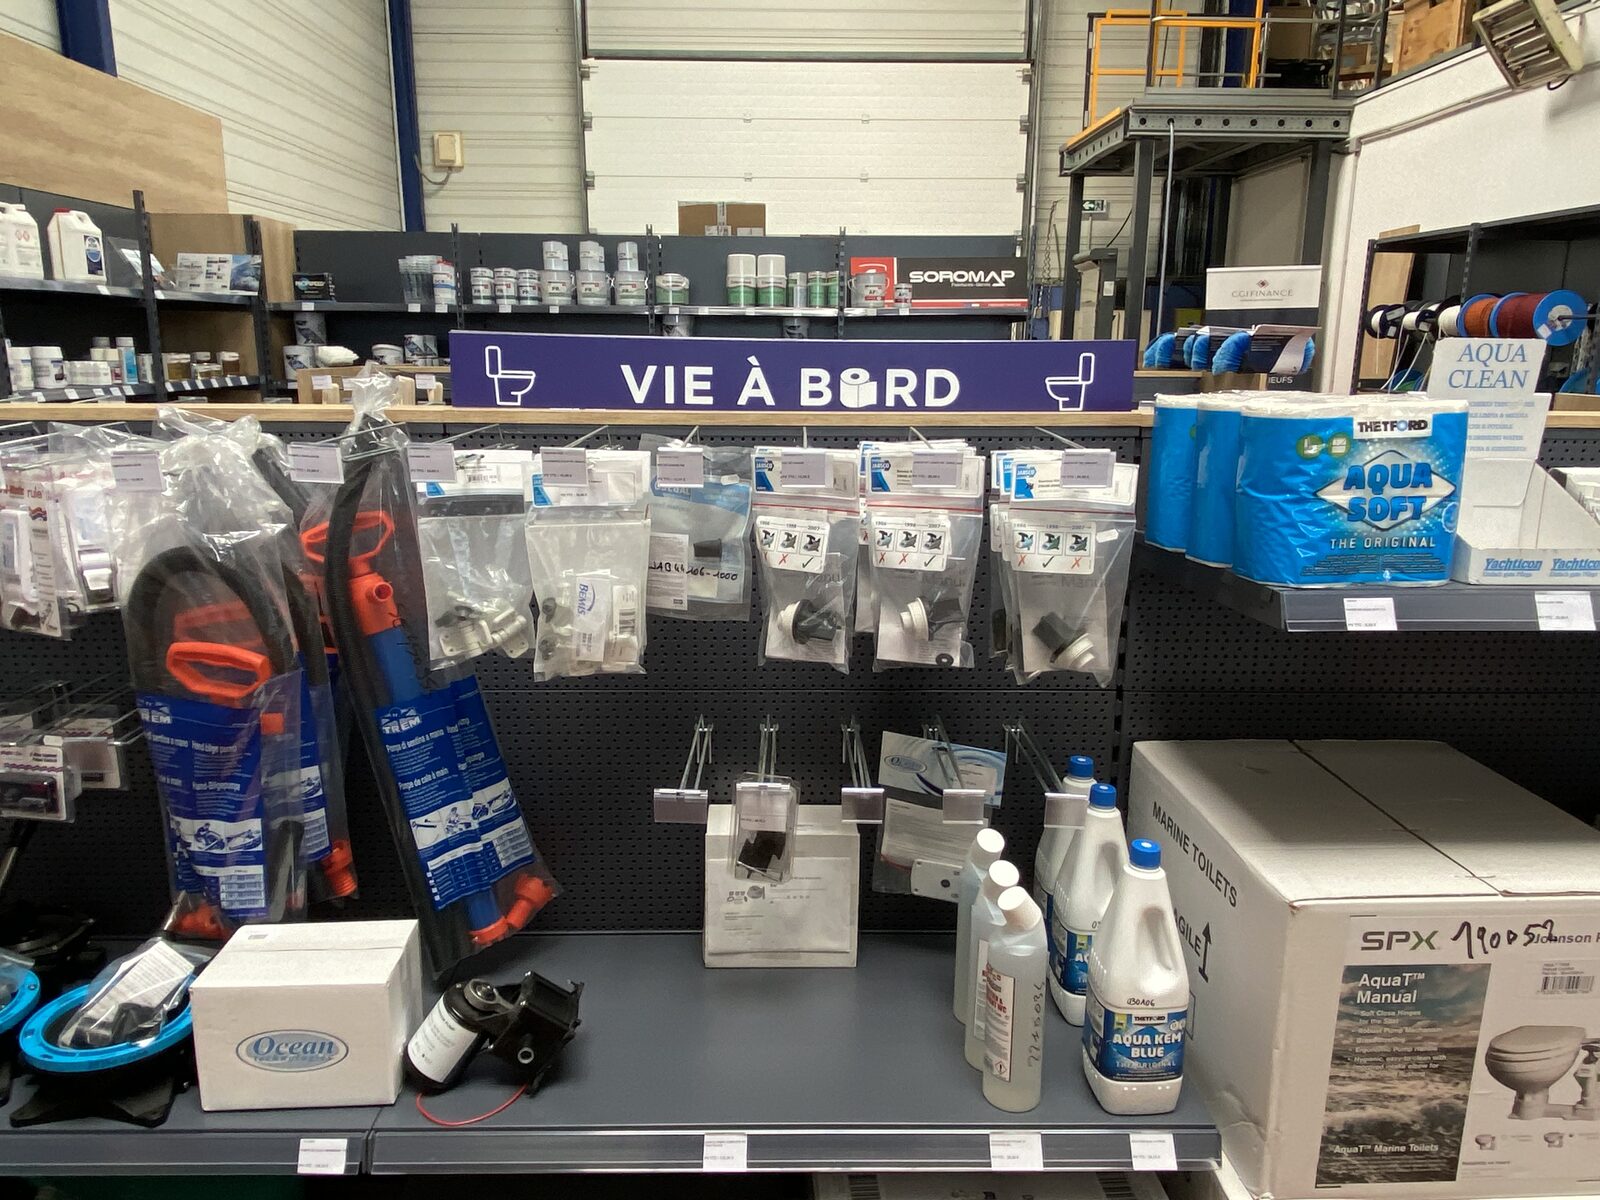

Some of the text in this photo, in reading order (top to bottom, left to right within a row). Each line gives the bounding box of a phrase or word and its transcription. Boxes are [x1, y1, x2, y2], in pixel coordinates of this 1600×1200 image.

[909, 270, 1015, 287] SOROMAP
[1457, 343, 1527, 367] AQUA
[620, 364, 714, 405] VIE
[737, 355, 775, 407] À
[1448, 369, 1530, 389] CLEAN
[1358, 420, 1428, 433] THETFORD
[1343, 463, 1433, 495] AQUA
[1347, 496, 1427, 522] SOFT
[1330, 537, 1436, 549] THE ORIGINAL
[1485, 558, 1543, 571] Yachticon
[577, 583, 589, 616] BEMIS
[382, 716, 421, 734] TREM
[436, 767, 449, 778] main
[1152, 801, 1237, 908] MARINE TOILETS
[1361, 931, 1438, 951] SPX
[1356, 990, 1417, 1004] Manual
[253, 1036, 334, 1056] Ocean
[1113, 1032, 1181, 1048] AQUA KEM
[1131, 1047, 1165, 1058] BLUE
[1374, 1144, 1406, 1152] Marine
[1409, 1143, 1439, 1152] Toilets
